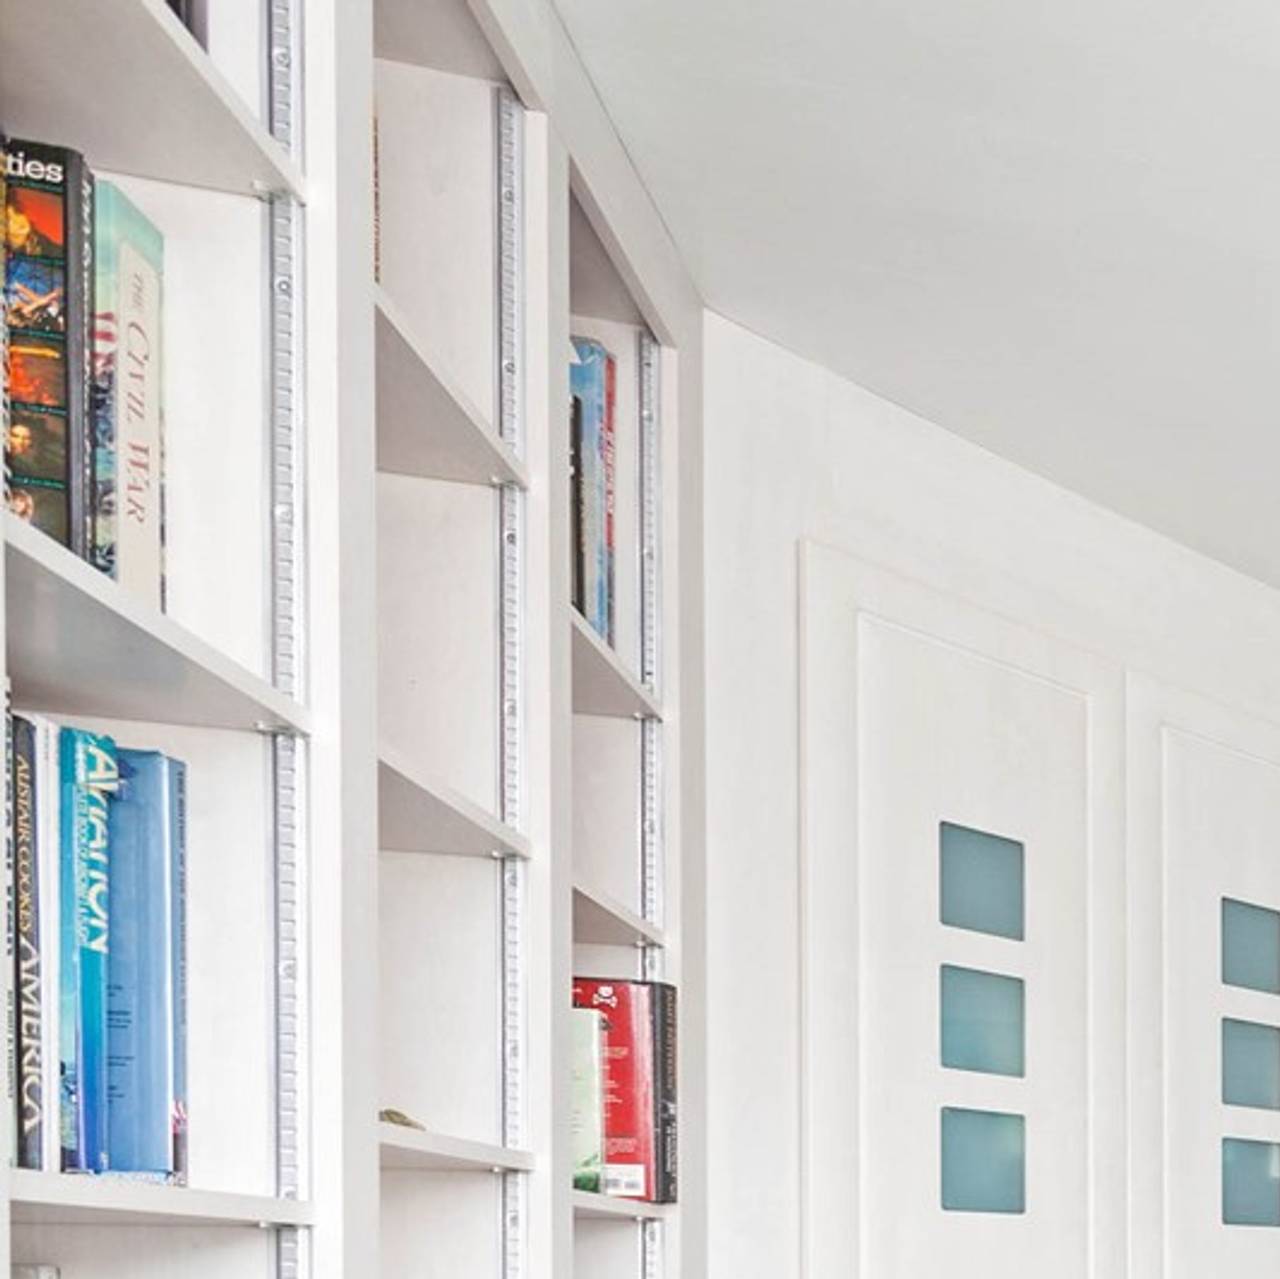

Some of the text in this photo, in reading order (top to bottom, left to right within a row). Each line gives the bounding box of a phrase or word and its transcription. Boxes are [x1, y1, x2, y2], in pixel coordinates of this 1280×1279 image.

[127, 321, 150, 424] CIVIL
[127, 442, 150, 524] WAR
[16, 754, 31, 842] ALISTAIR
[20, 934, 42, 1133] AMERICA
